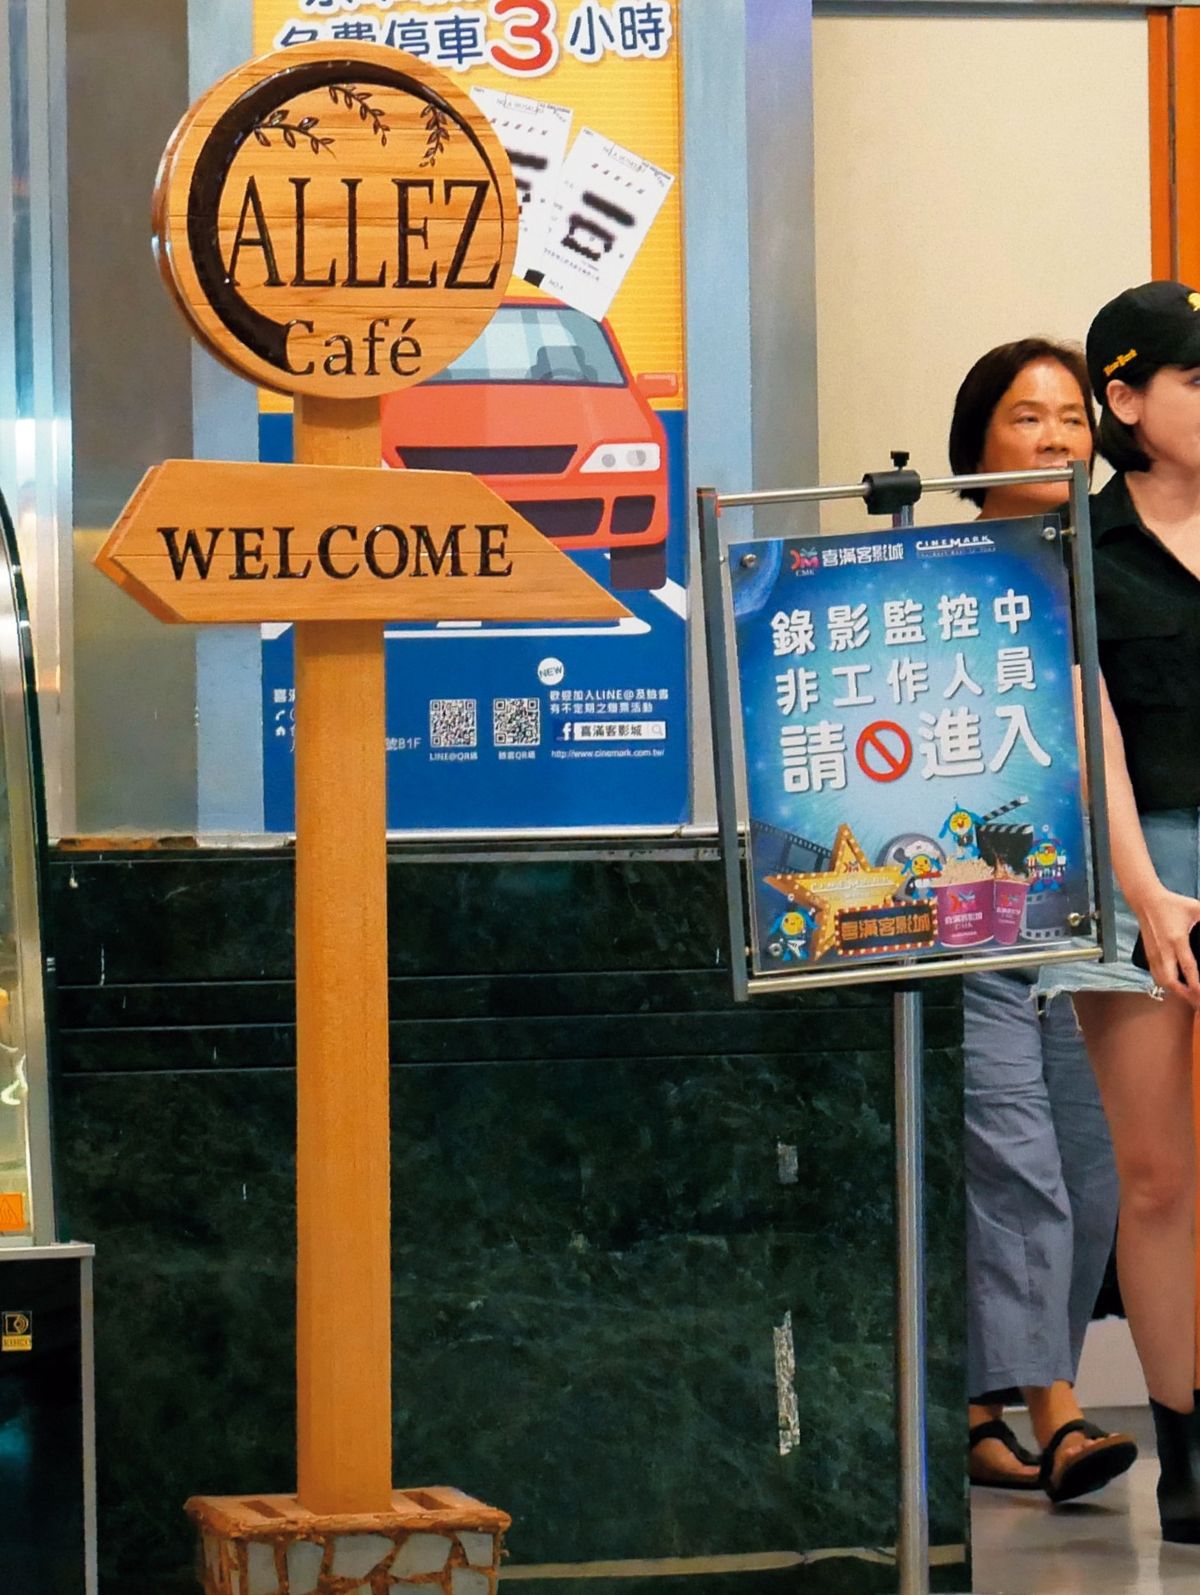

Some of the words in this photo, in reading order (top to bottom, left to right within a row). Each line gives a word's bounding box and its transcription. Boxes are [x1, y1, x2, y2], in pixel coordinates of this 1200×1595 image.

[225, 175, 501, 290] ALLEZ
[283, 318, 423, 377] Café
[157, 523, 514, 581] WELCOME
[822, 543, 904, 567] 喜滿客影城
[771, 589, 1032, 656] 錄影監控中
[539, 666, 563, 678] NEW
[775, 646, 1037, 716] 非工作人員
